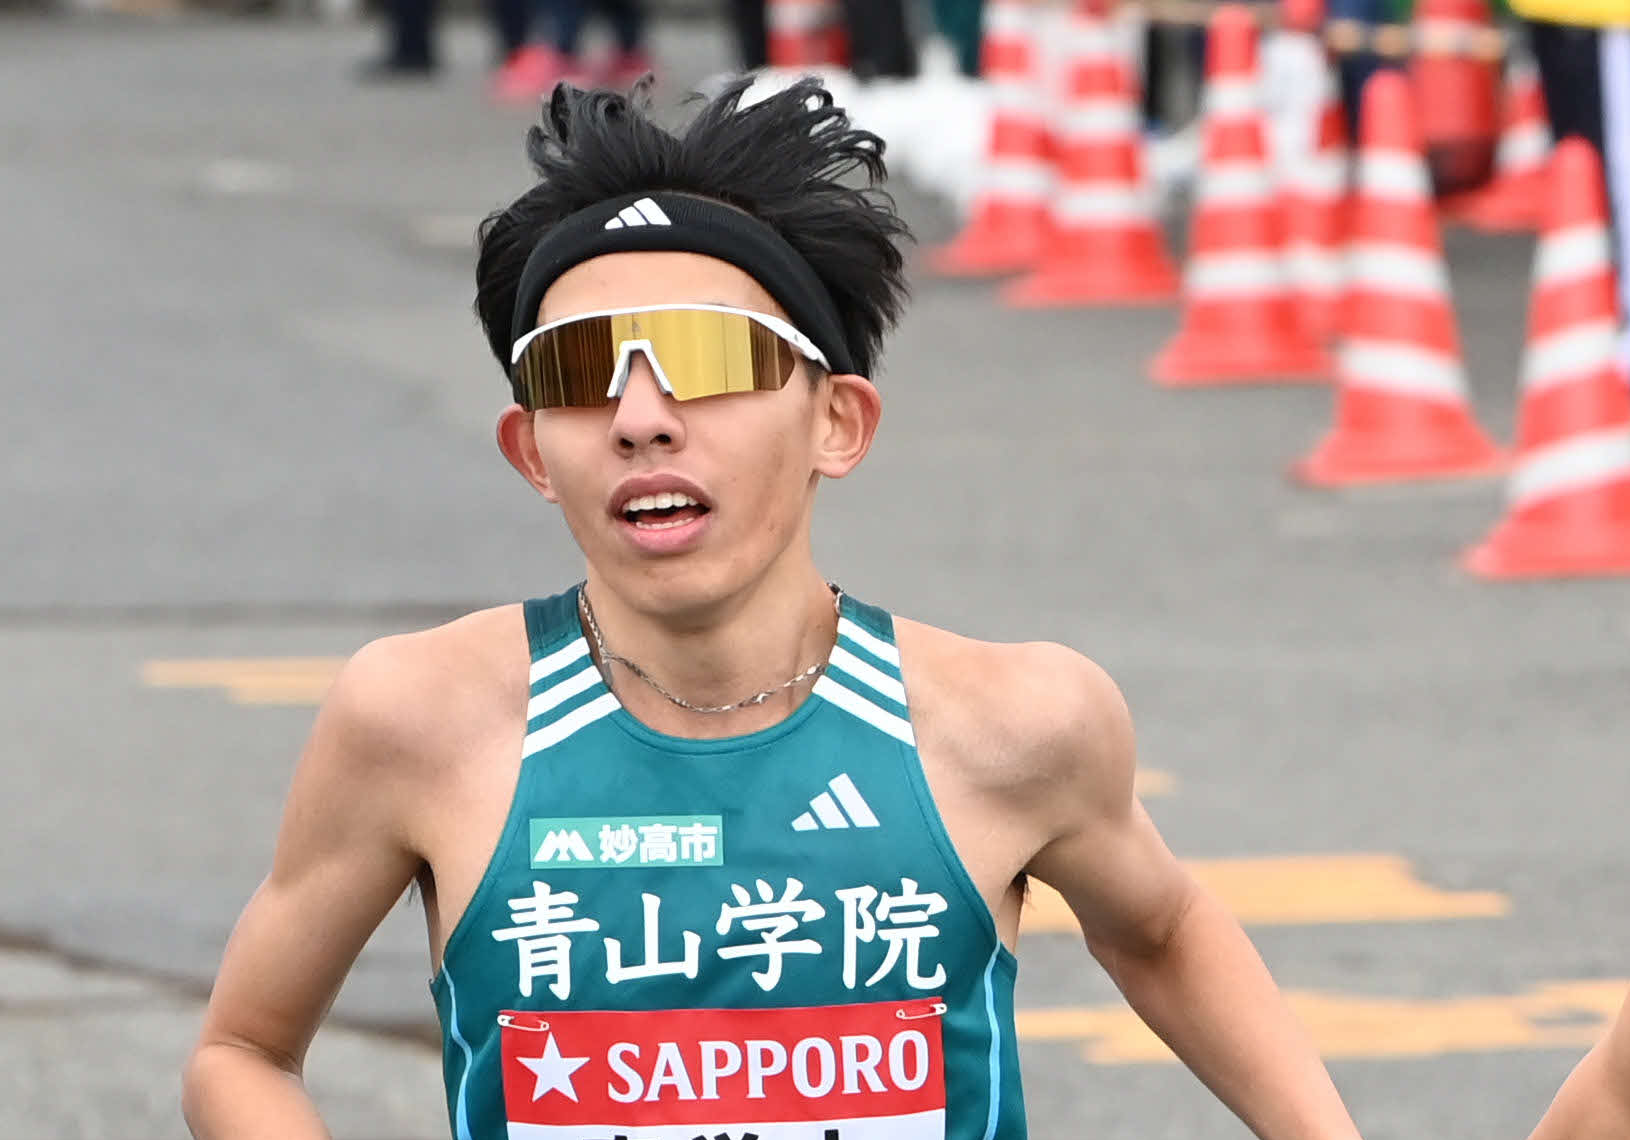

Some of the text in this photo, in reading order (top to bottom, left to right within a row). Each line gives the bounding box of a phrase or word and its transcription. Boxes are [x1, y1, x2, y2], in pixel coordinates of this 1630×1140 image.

[598, 822, 718, 866] 妙高市
[491, 876, 949, 1001] 青山学院
[606, 1030, 929, 1102] SAPPORO
